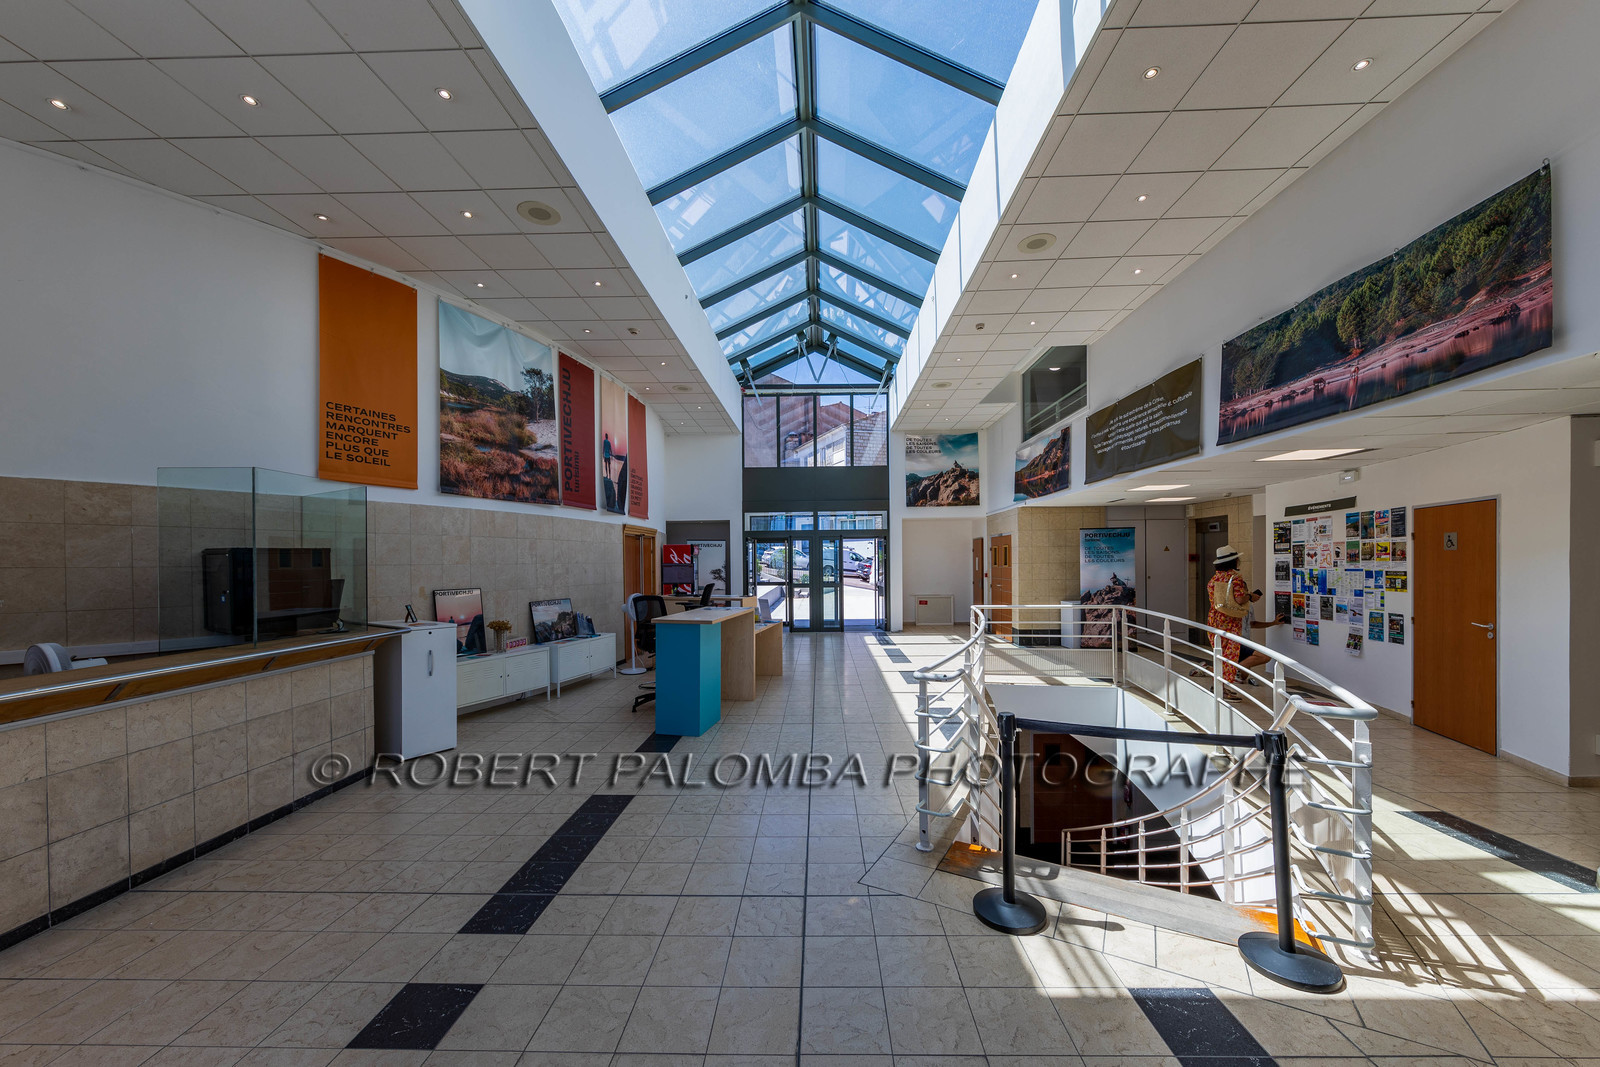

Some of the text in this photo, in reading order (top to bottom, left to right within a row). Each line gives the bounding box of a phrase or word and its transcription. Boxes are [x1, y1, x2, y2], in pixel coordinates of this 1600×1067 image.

[325, 401, 396, 422] CERTAINES
[326, 411, 411, 434] RENCONTRES
[326, 421, 398, 441] MARQUENT
[562, 367, 573, 493] PORTIVECHJU
[326, 431, 379, 447] ENCORE
[326, 441, 389, 457] PLUS QUE
[326, 451, 391, 467] LE SOLEIL
